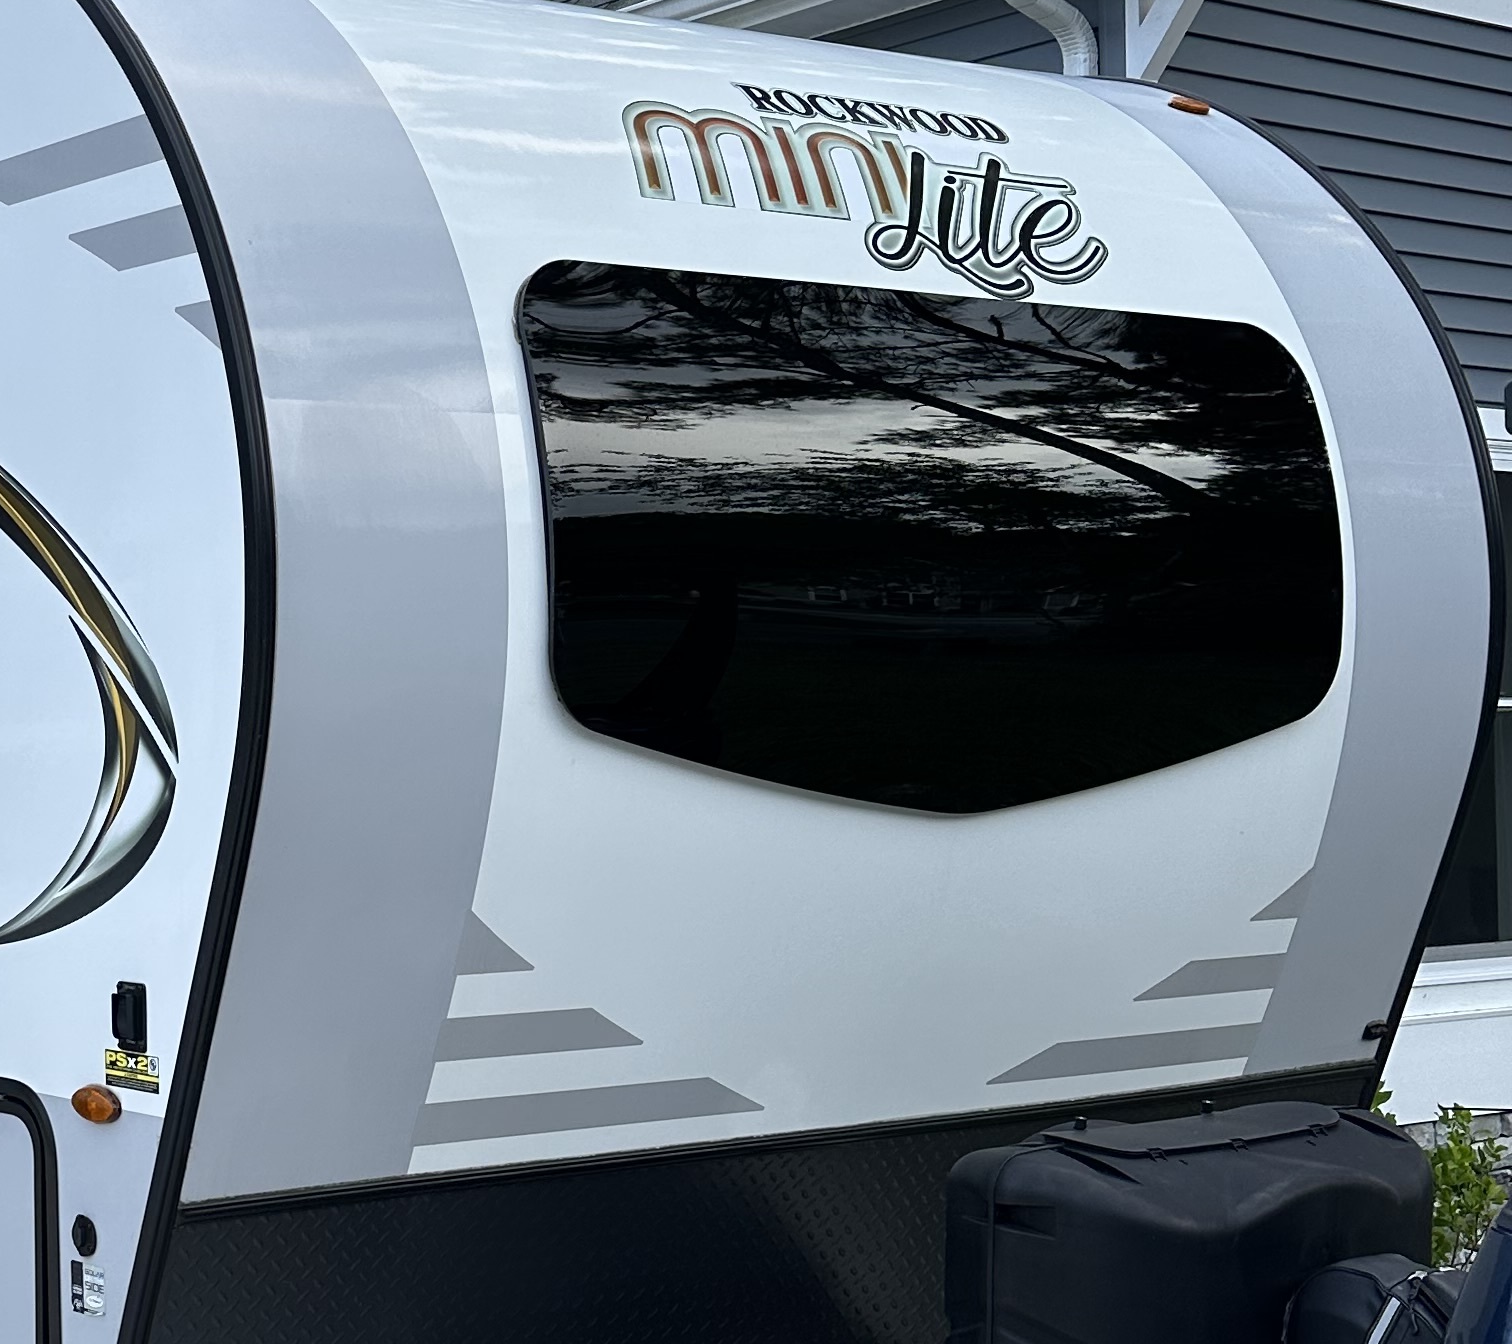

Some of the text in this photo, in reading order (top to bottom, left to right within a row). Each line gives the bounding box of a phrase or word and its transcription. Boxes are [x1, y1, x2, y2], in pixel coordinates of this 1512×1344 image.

[733, 83, 1009, 145] ROCKWOOD
[623, 101, 1108, 300] mini Lite
[106, 1051, 148, 1071] PSx2
[85, 1281, 105, 1295] SIDE
